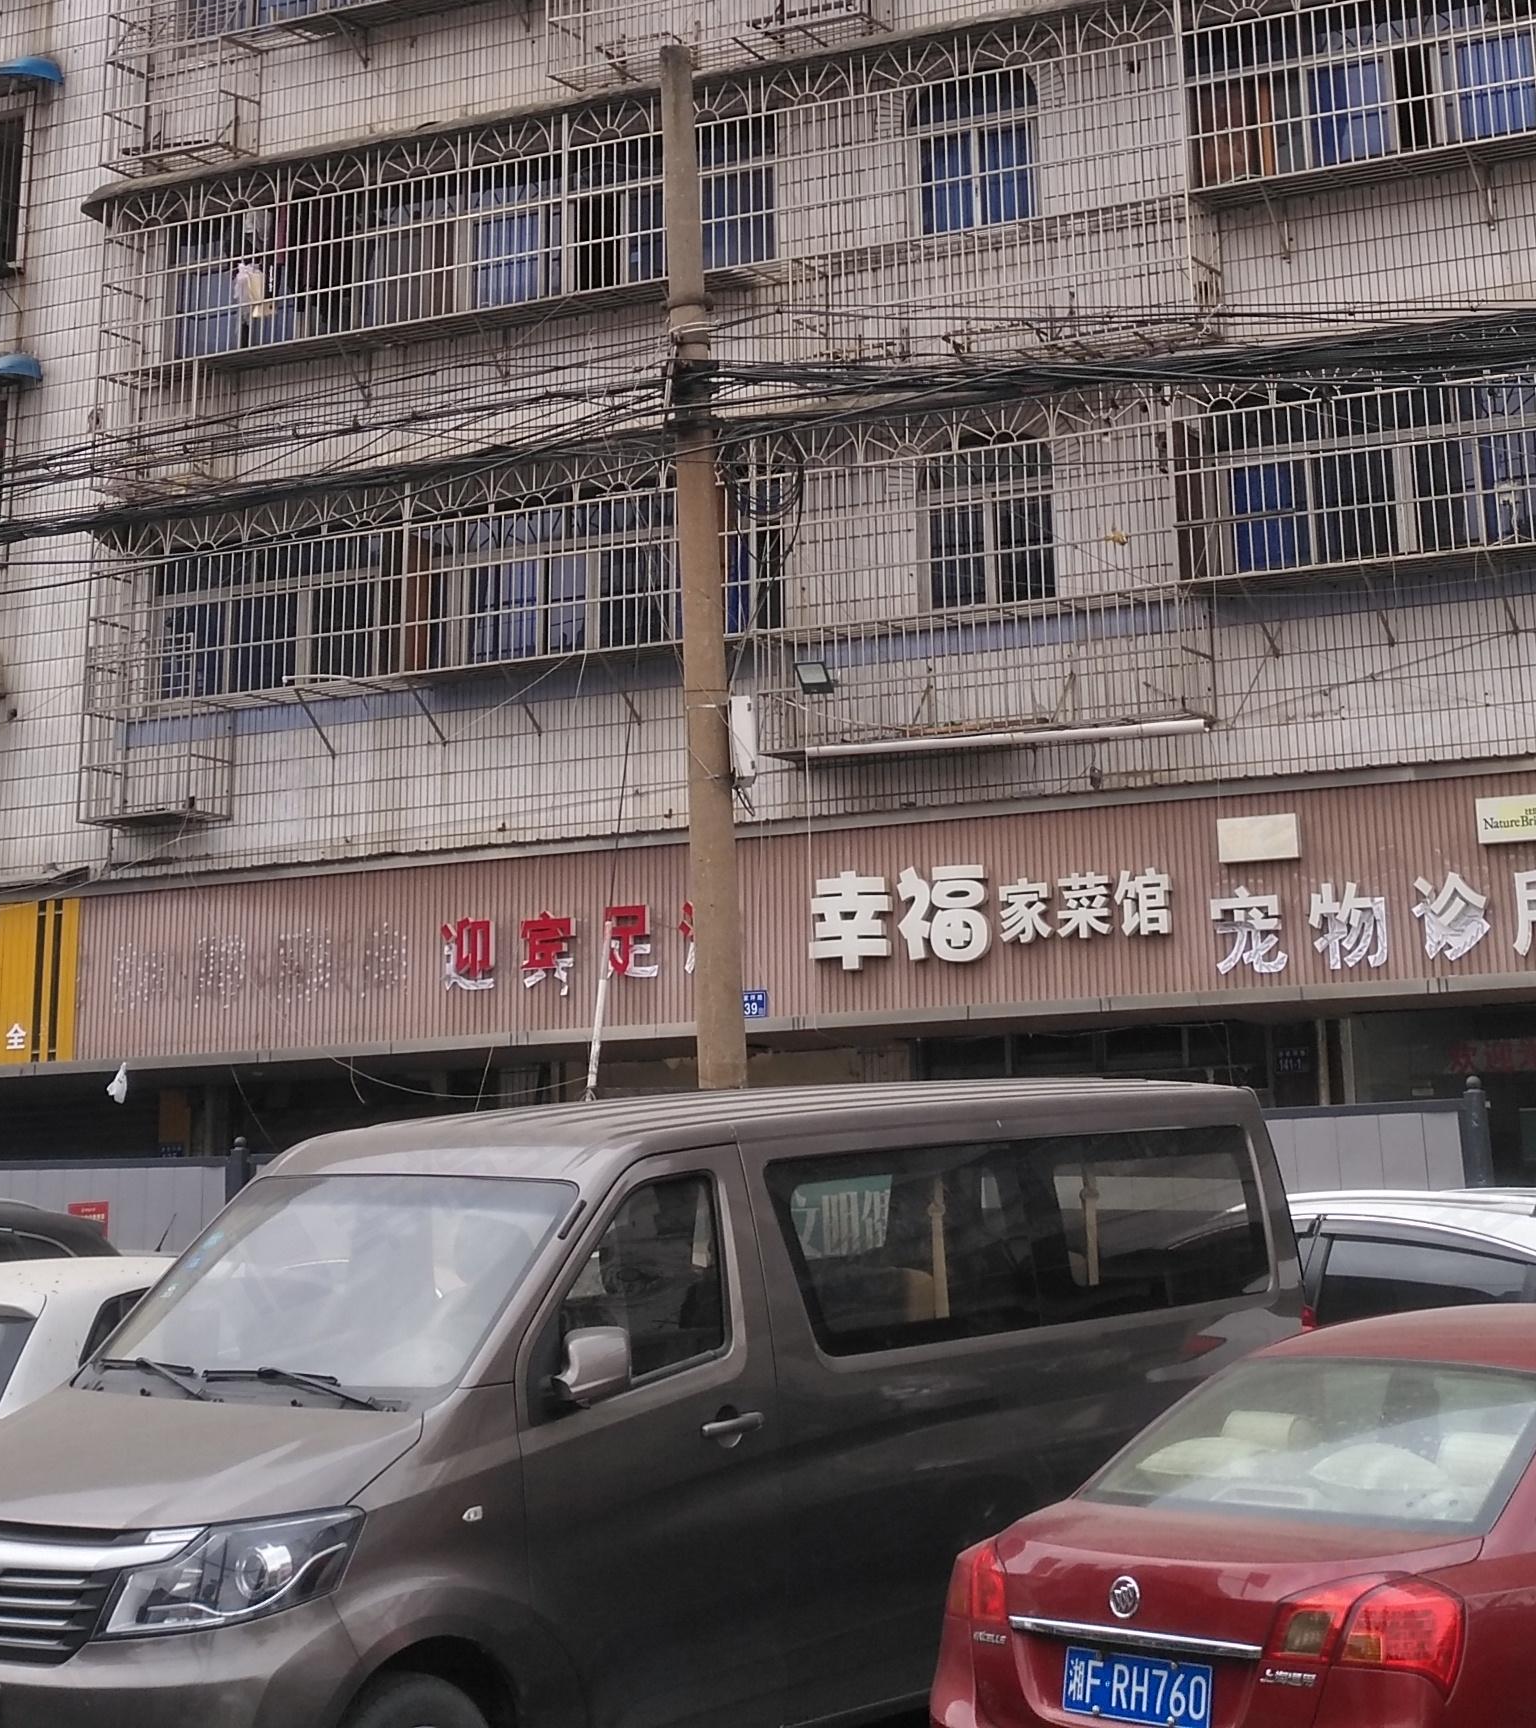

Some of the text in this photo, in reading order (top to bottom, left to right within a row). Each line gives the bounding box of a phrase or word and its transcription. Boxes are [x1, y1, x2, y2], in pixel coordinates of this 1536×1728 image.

[439, 900, 696, 996] 迎宾足
[808, 864, 1173, 972] 幸福家菜馆
